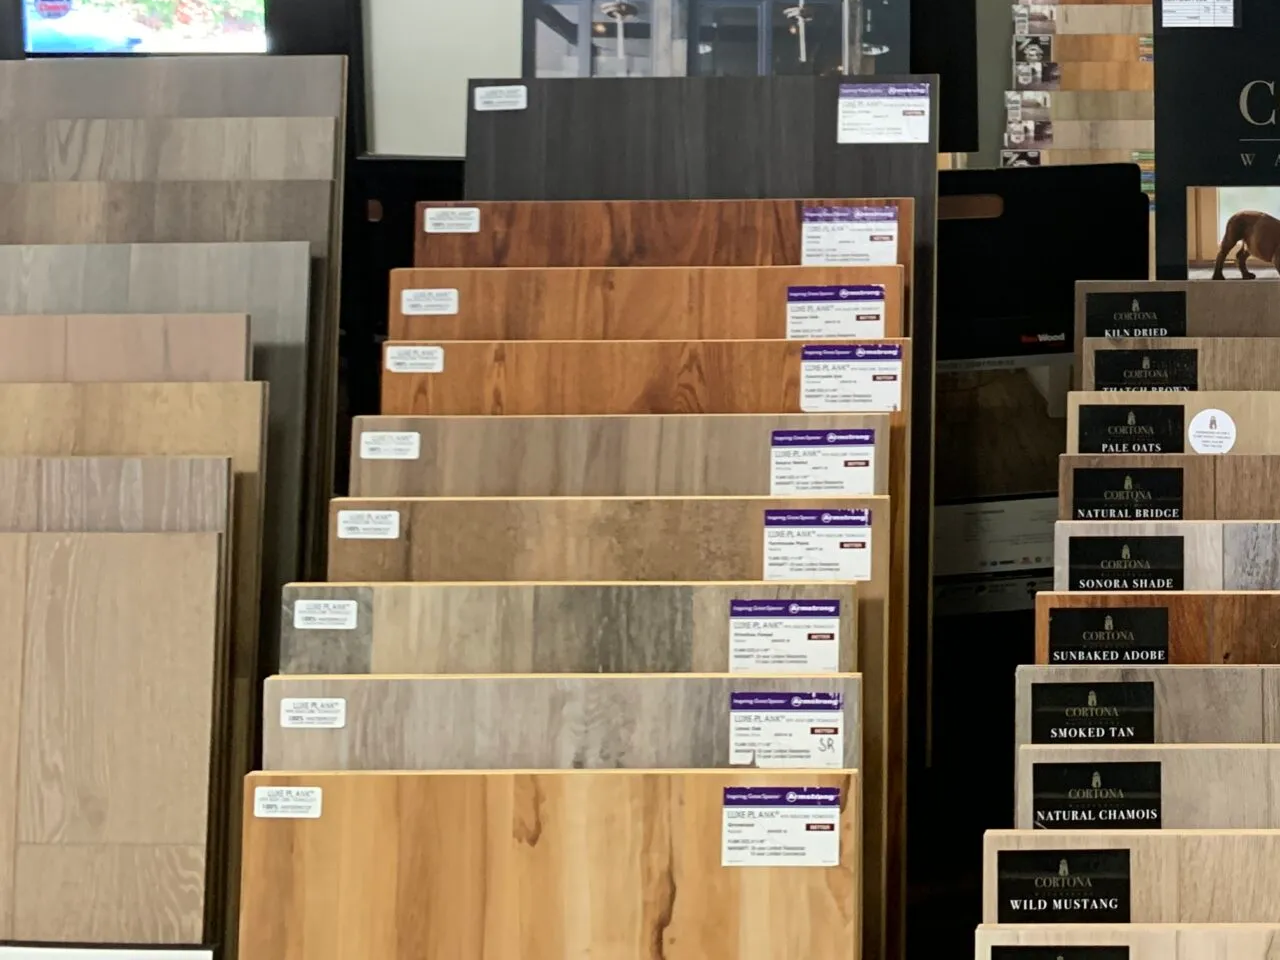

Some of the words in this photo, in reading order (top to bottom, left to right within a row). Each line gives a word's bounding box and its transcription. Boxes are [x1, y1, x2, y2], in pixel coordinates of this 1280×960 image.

[1113, 311, 1158, 321] CORTONA
[1104, 328, 1131, 338] KILN
[1133, 327, 1168, 337] DRIED
[1123, 368, 1169, 379] CORTONA
[1107, 424, 1155, 435] CORTONA
[826, 432, 870, 443] Armstrong
[1101, 443, 1129, 453] PALE
[1132, 442, 1162, 452] OATS
[1103, 490, 1152, 501] CORTONA
[820, 512, 866, 523] Armstrong
[1077, 508, 1132, 519] NATURAL
[1135, 508, 1180, 518] BRIDGE
[1100, 559, 1151, 570] CORTONA
[1079, 578, 1128, 589] SONORA
[1132, 578, 1174, 589] SHADE
[788, 603, 836, 614] Armstrong
[1082, 630, 1135, 641] CORTONA
[1053, 651, 1119, 662] SUNBAKED
[1123, 650, 1165, 661] ADOBE
[790, 696, 840, 708] Armstrong
[1065, 706, 1119, 717] CORTONA
[1050, 727, 1105, 738] SMOKED
[1110, 726, 1135, 737] TAN
[786, 791, 837, 803] Armstrong
[1068, 788, 1124, 800] CORTONA
[1036, 810, 1096, 822] NATURAL
[1099, 809, 1158, 821] CHAMOIS
[1034, 876, 1092, 889] CORTONA
[1010, 898, 1047, 910] WILD
[1052, 897, 1119, 910] MUSTANG
